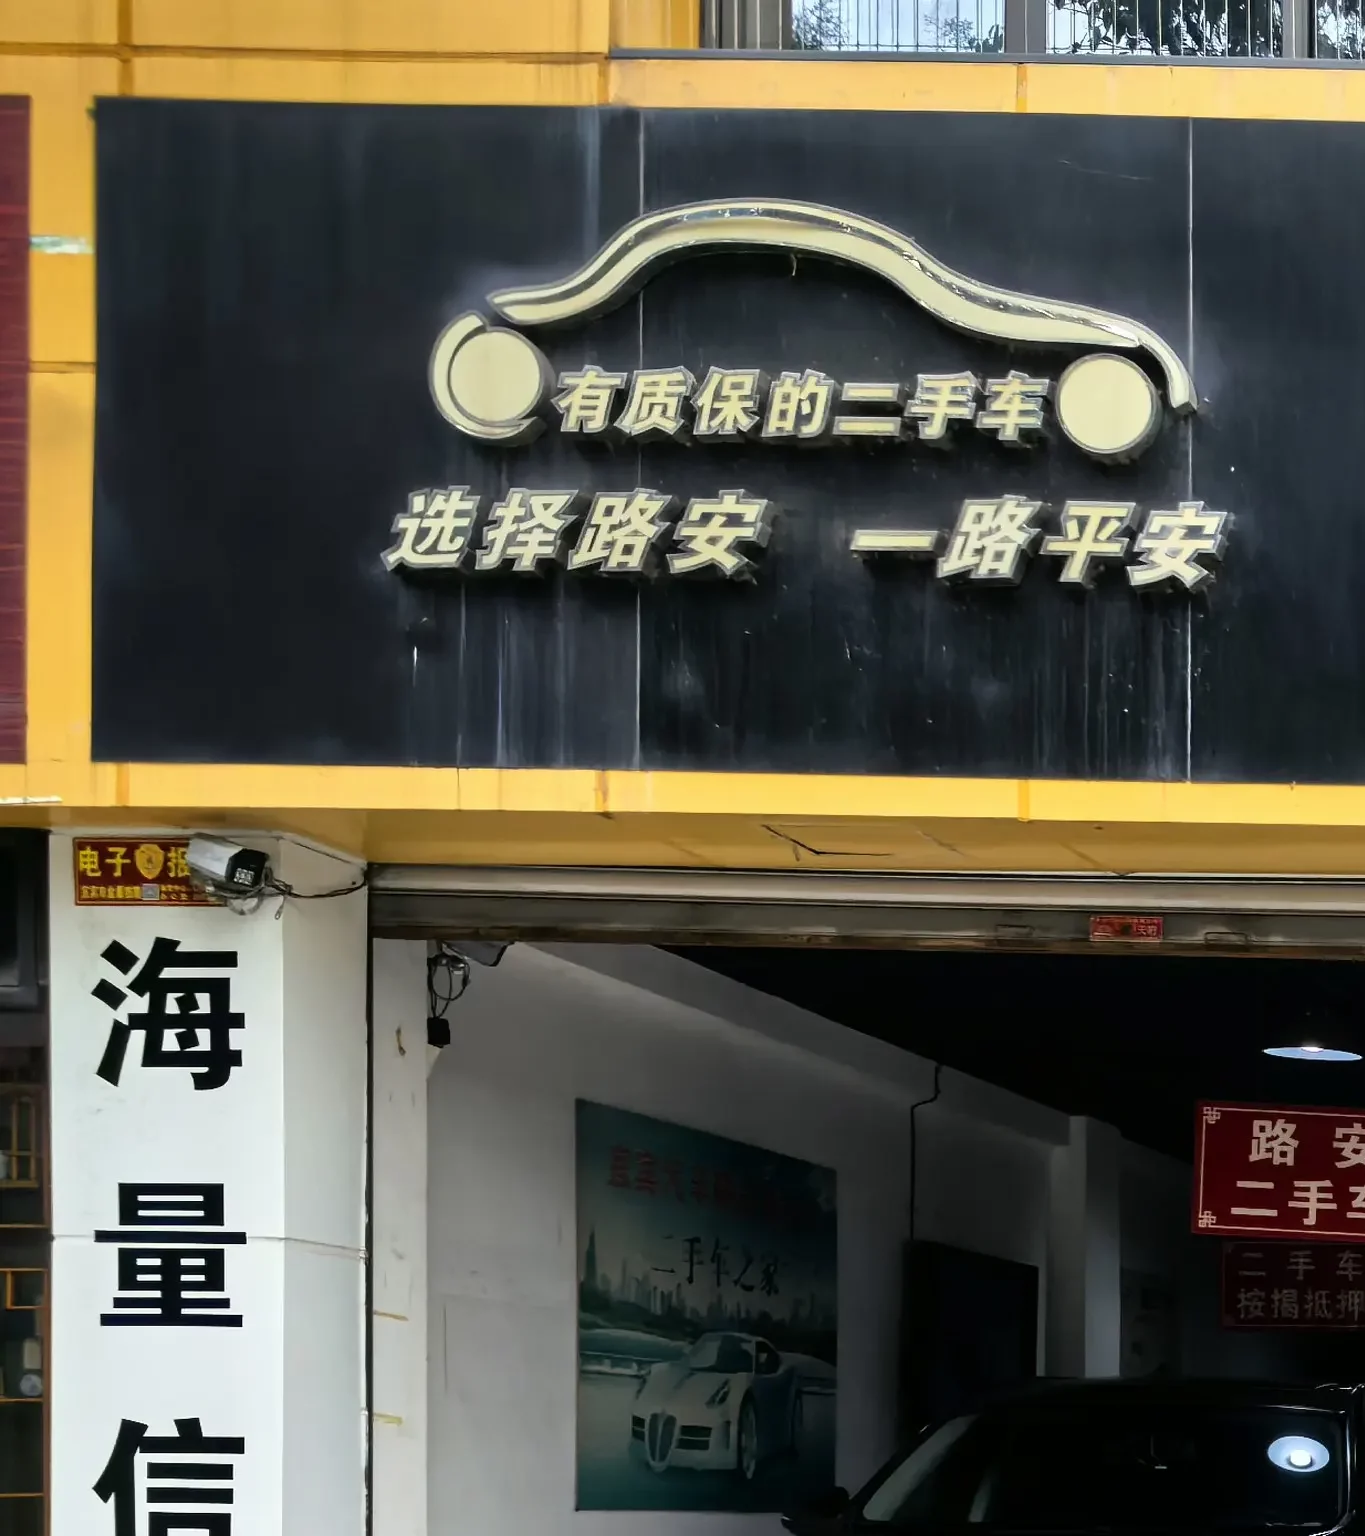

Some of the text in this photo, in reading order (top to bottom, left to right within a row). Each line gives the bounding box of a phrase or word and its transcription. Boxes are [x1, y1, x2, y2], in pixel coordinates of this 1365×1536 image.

[552, 364, 1058, 444] 有质保的二手车
[383, 485, 1232, 591] 选择路安 一路平安
[1238, 1249, 1364, 1282] 二手车
